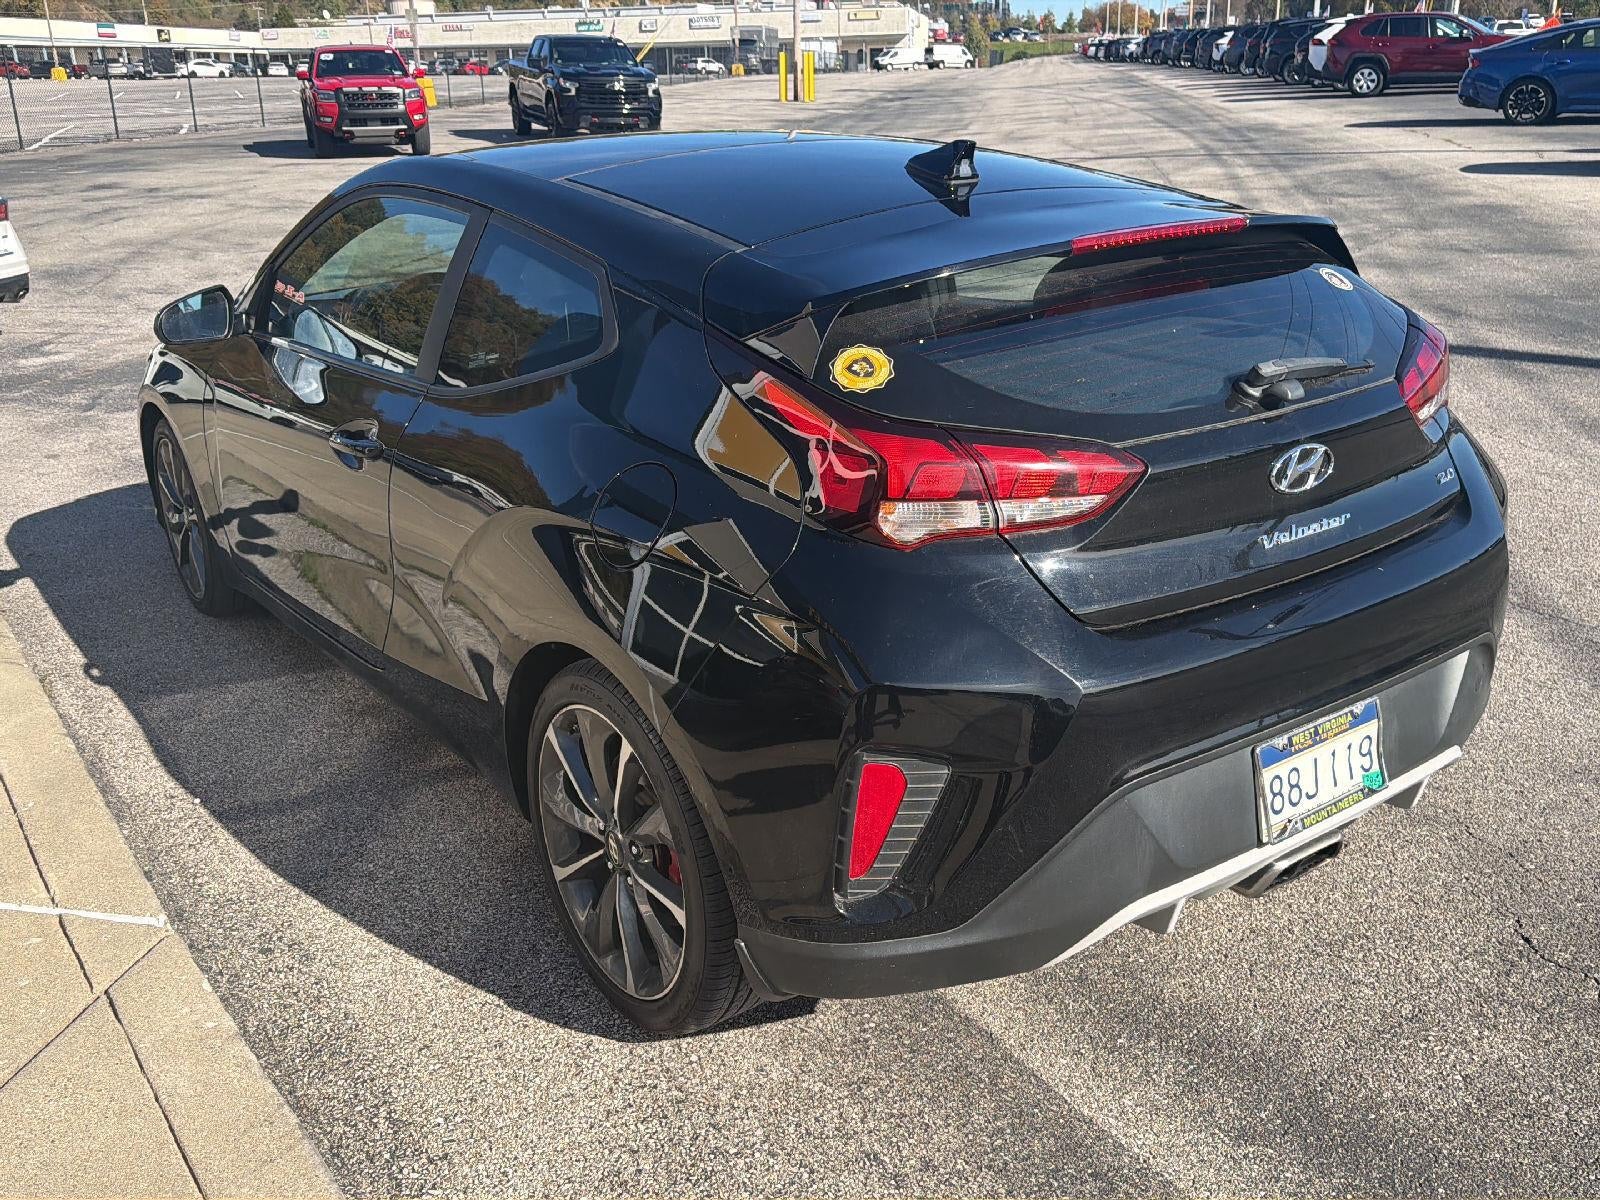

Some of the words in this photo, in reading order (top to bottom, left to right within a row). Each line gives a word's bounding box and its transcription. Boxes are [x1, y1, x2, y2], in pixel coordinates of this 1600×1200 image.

[1257, 512, 1352, 550] Veloster
[1291, 727, 1316, 746] WEST
[1317, 712, 1353, 735] VIRGINIA
[1303, 791, 1365, 828] MOUNTAINEERS
